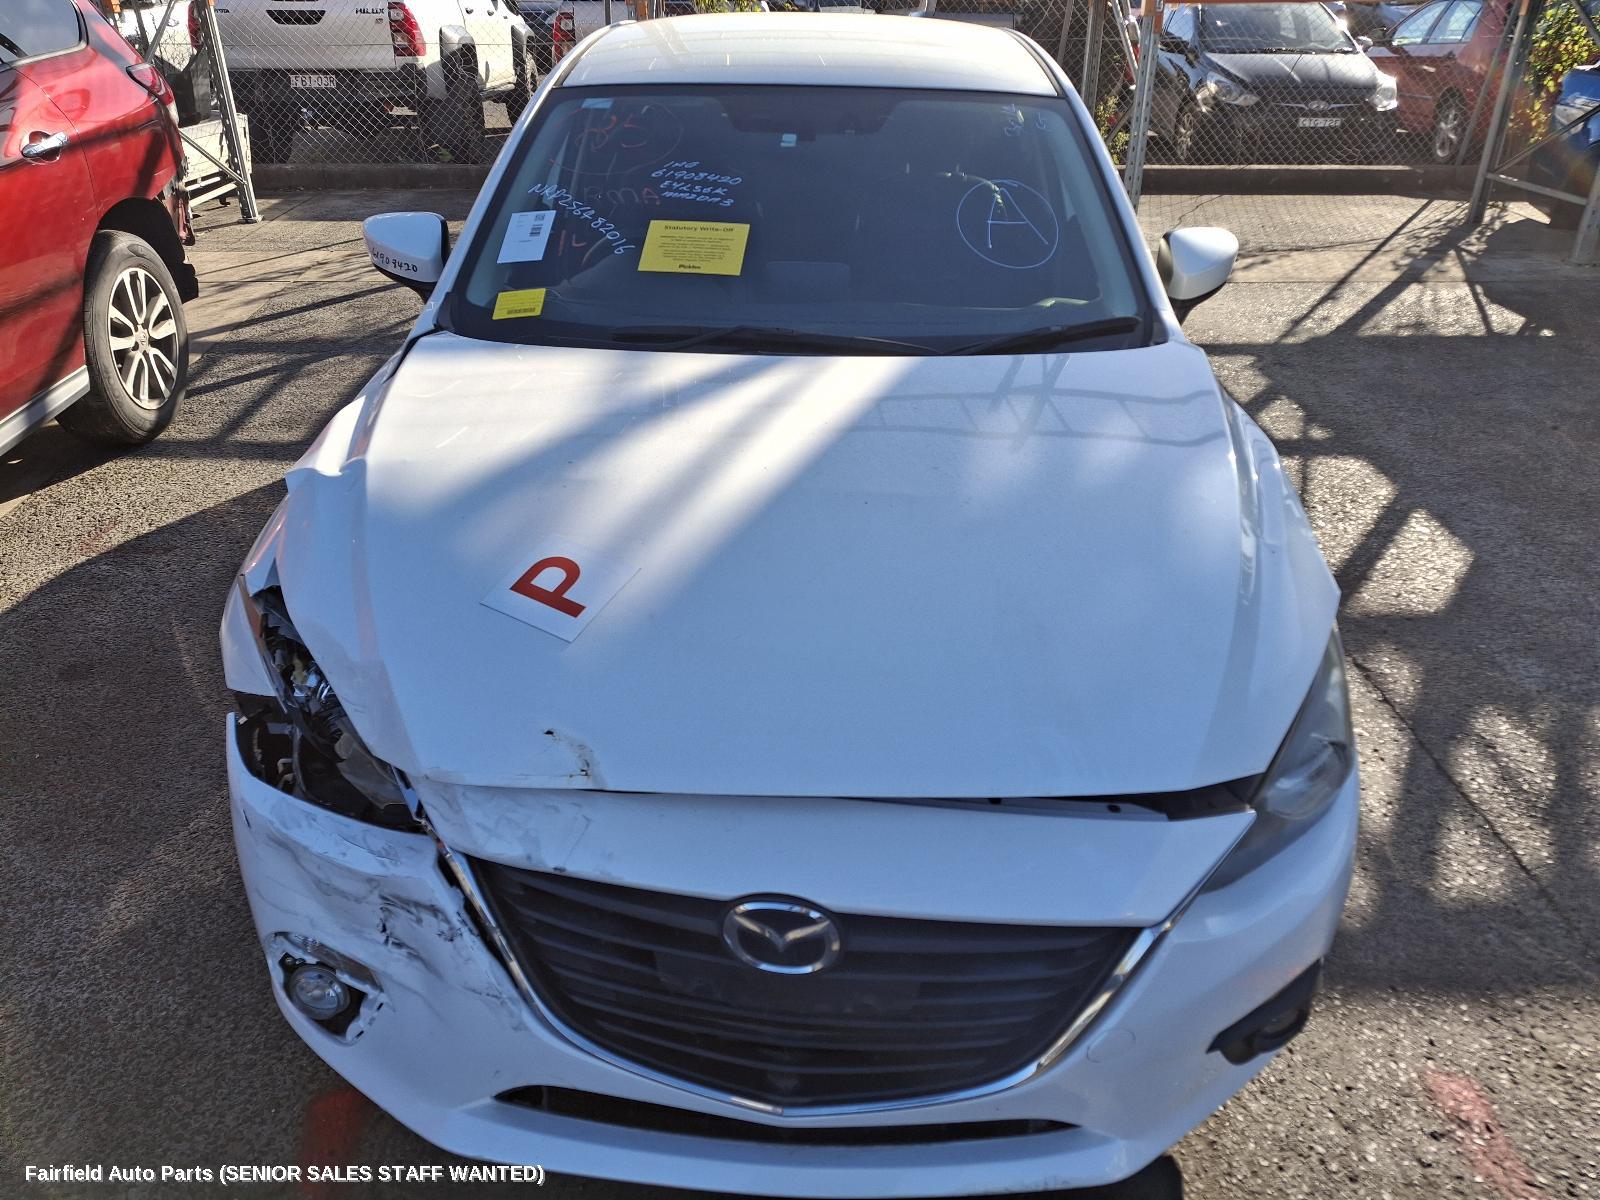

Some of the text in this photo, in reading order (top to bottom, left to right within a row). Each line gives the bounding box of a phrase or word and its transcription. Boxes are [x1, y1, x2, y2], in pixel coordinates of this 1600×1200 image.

[664, 224, 697, 232] Statutory
[986, 187, 1049, 249] A
[509, 556, 587, 618] P
